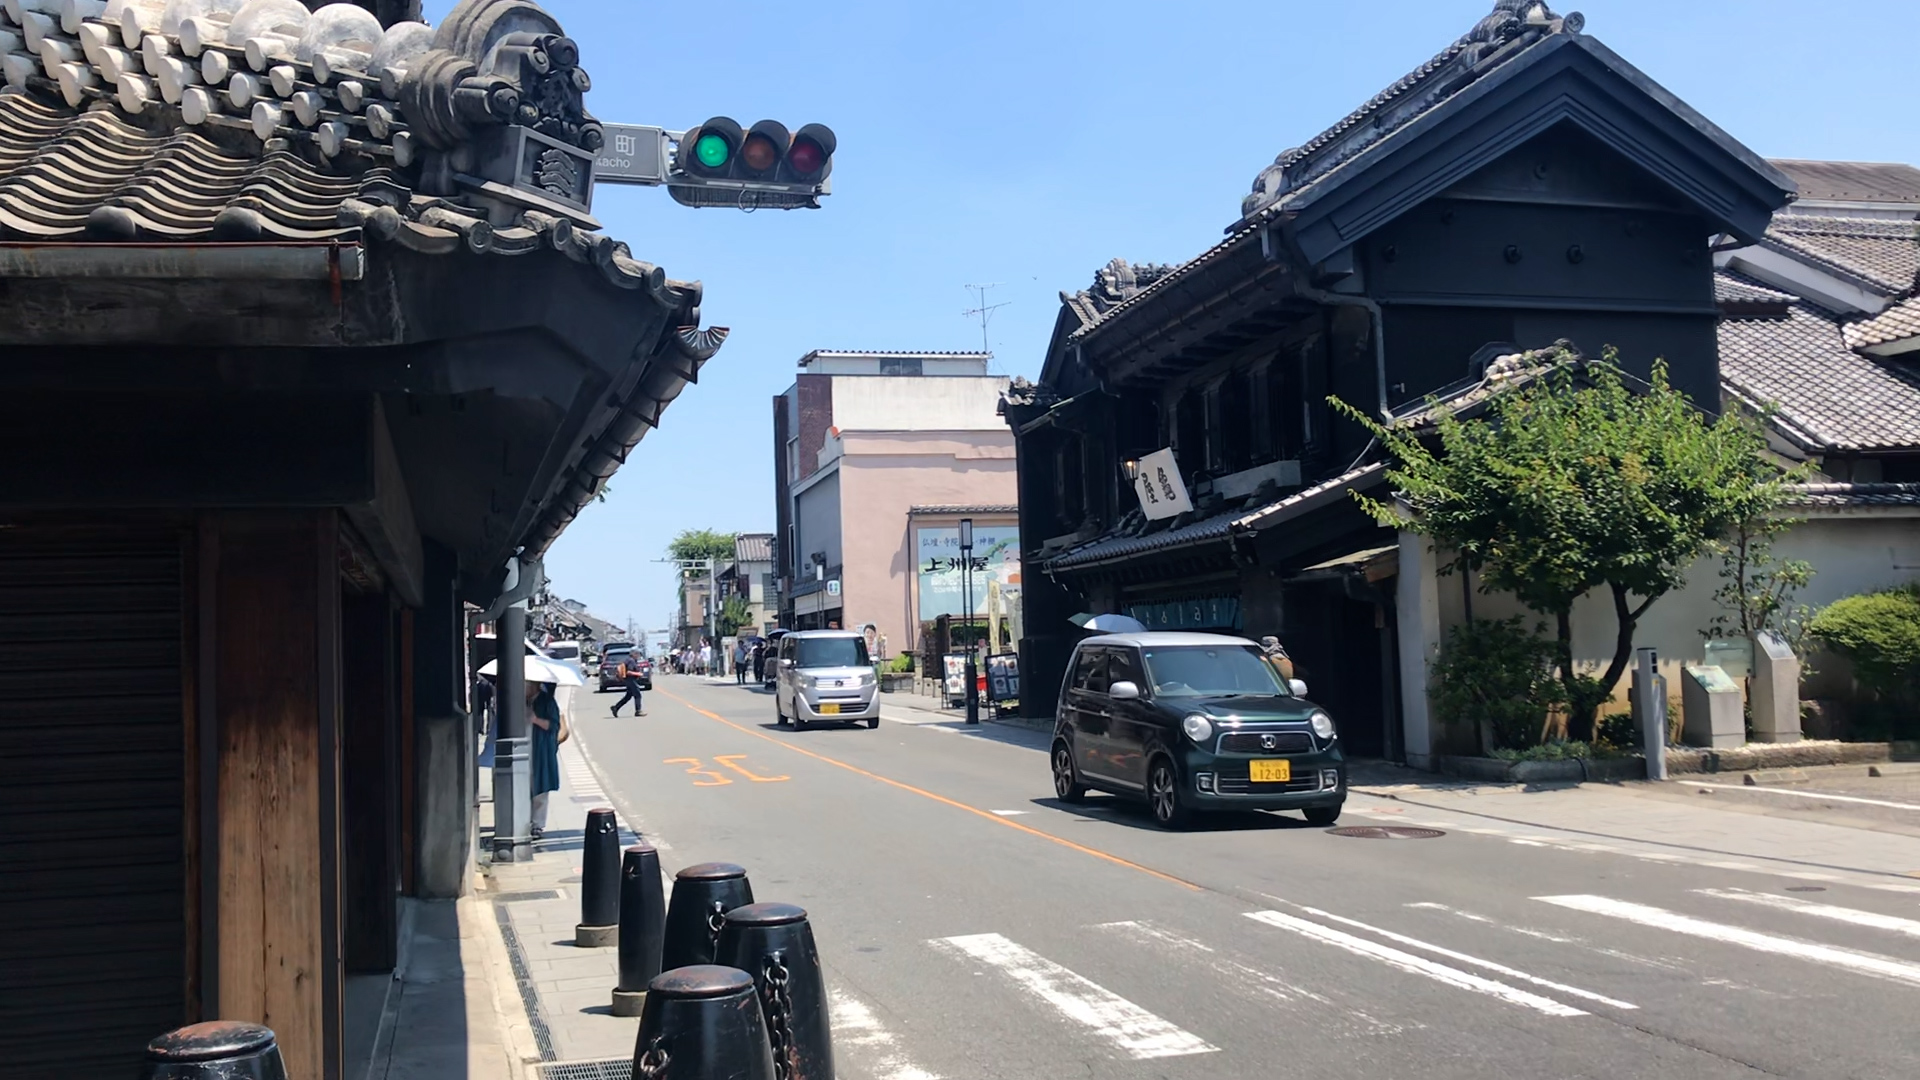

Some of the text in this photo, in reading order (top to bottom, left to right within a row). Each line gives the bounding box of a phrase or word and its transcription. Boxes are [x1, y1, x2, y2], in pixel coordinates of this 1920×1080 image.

[615, 134, 637, 157] 町
[924, 556, 992, 573] 上州屋
